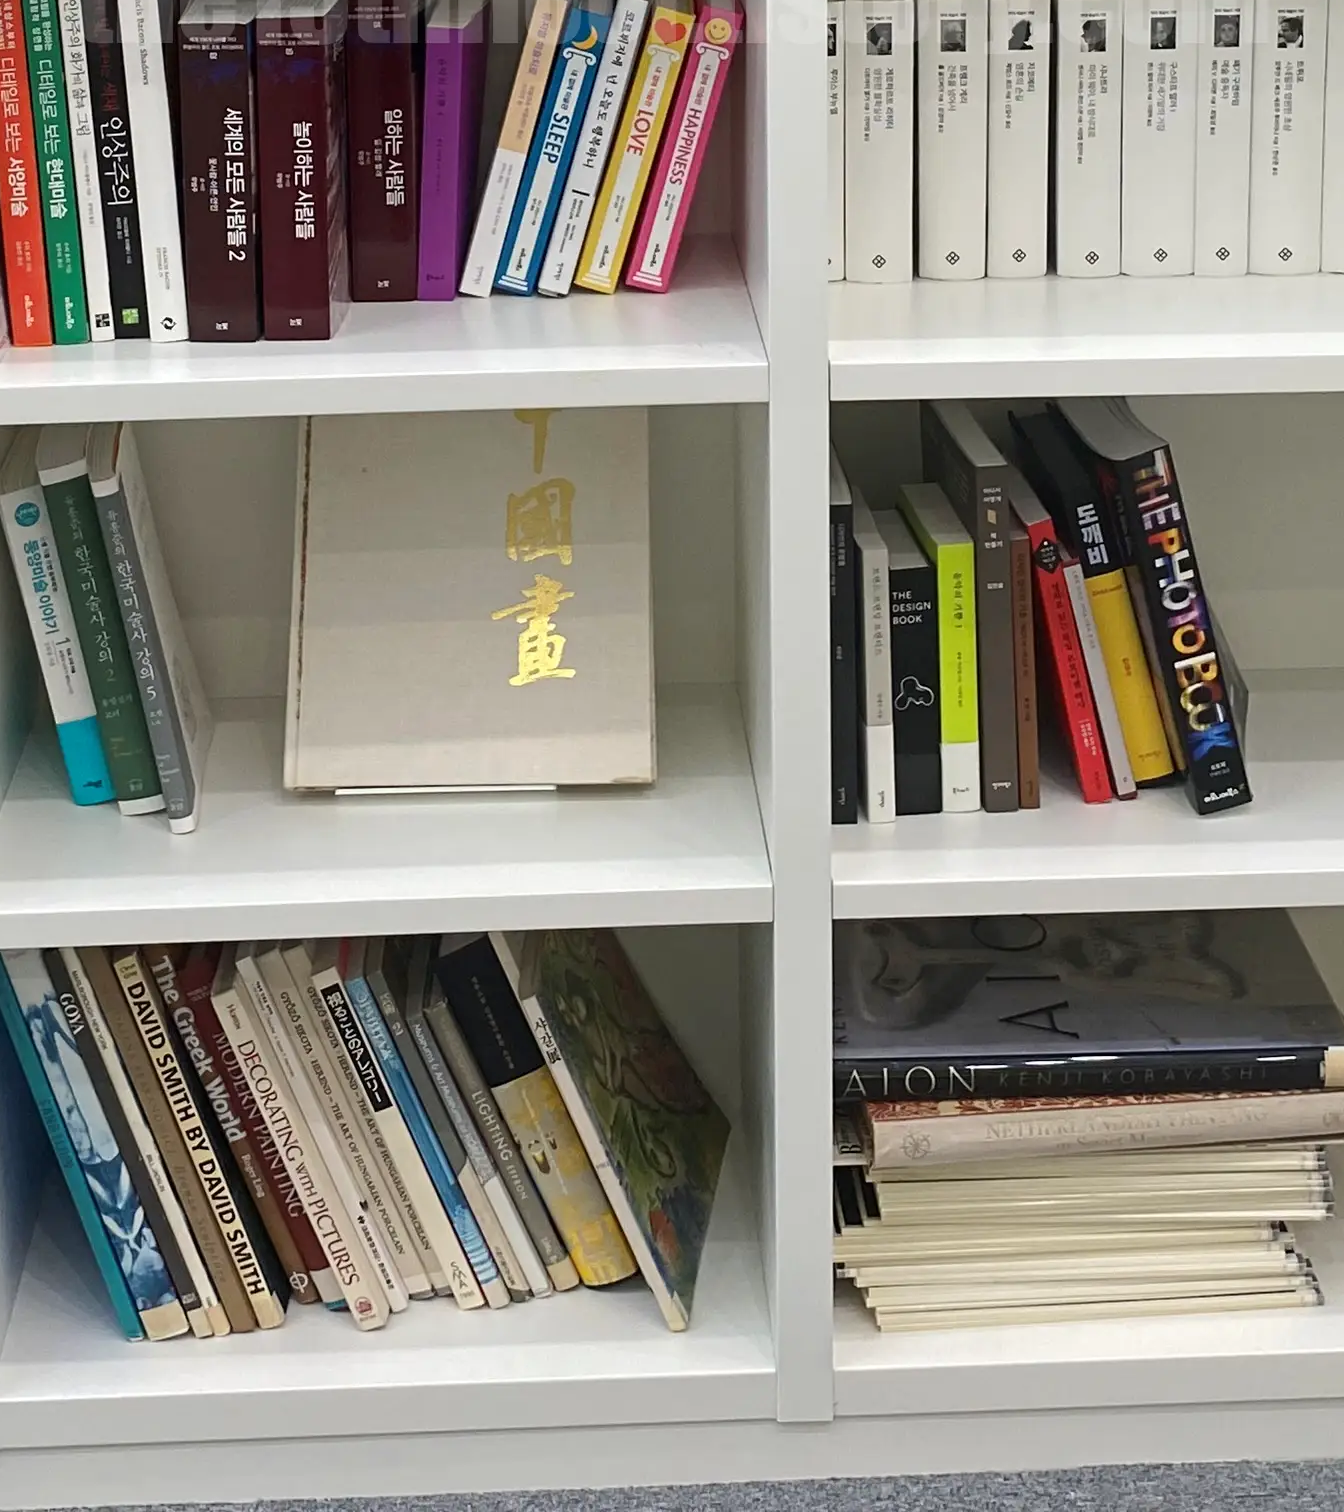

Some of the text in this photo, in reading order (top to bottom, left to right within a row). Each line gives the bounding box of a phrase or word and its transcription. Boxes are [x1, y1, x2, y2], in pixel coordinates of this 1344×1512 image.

[0, 56, 19, 118] 디테일로
[3, 122, 21, 154] 보는
[38, 58, 67, 220] 디테일로 보는 현대미술
[97, 116, 133, 208] 인상주의
[384, 108, 405, 207] 일하는 사람들
[543, 112, 570, 164] SLEEP
[626, 109, 655, 157] LOVE
[669, 109, 703, 187] HAPPINESS
[6, 156, 28, 218] 서양미술
[223, 107, 247, 262] 세계의 모든 사람들 2
[292, 121, 315, 241] 놀이하는 사람들
[1076, 503, 1110, 566] 도깨비
[22, 538, 61, 636] 동양미술 이야기
[74, 544, 114, 664] 한국미술사 강의
[892, 591, 912, 601] THE
[892, 600, 931, 613] DESIGN
[892, 615, 923, 624] BOOK
[116, 560, 158, 701] 한국미술사 강의 5
[55, 990, 88, 1037] GOYA
[147, 956, 248, 1145] The Greek World
[844, 1064, 1270, 1098] AION KENJI KOBAYASHI
[124, 980, 269, 1297] DAVID SMITH BY DAVID SMITH
[209, 1029, 307, 1221] MODERN PAINTING
[236, 1038, 361, 1289] DECORATING WITH PICTURES
[309, 1058, 407, 1257] HEREND THE ART OF HUNGARIAN PORCELAIN
[470, 1088, 515, 1164] LIGHTING
[238, 1152, 268, 1200] Roger Ling
